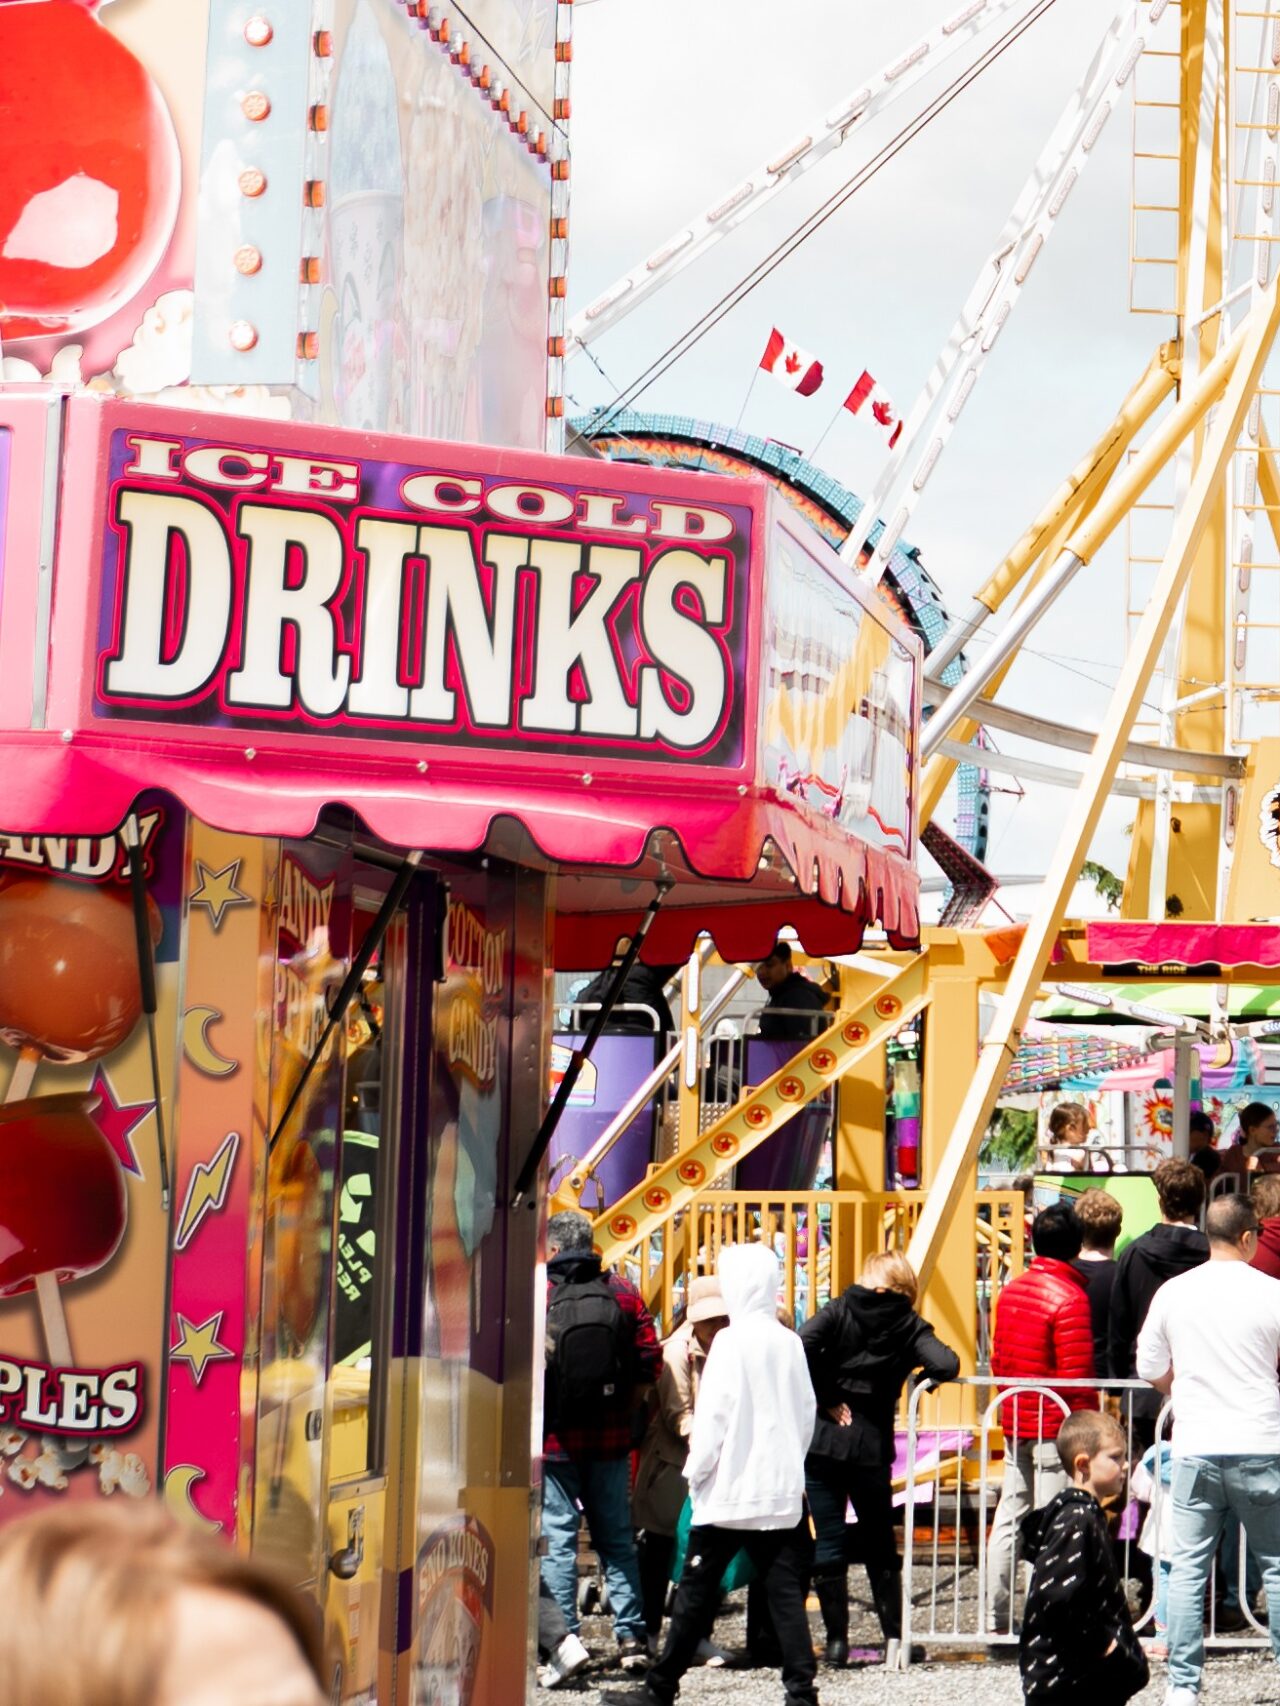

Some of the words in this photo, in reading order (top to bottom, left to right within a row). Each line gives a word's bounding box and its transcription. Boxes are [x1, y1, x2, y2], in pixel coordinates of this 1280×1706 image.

[126, 435, 359, 501] ICE
[401, 472, 735, 541] COLD
[104, 490, 728, 751] DRINKS
[1137, 965, 1159, 974] THE
[1162, 965, 1187, 974] RIDE
[449, 998, 497, 1081] CANDY
[419, 1537, 447, 1606] SNO
[449, 1529, 489, 1586] KONES
